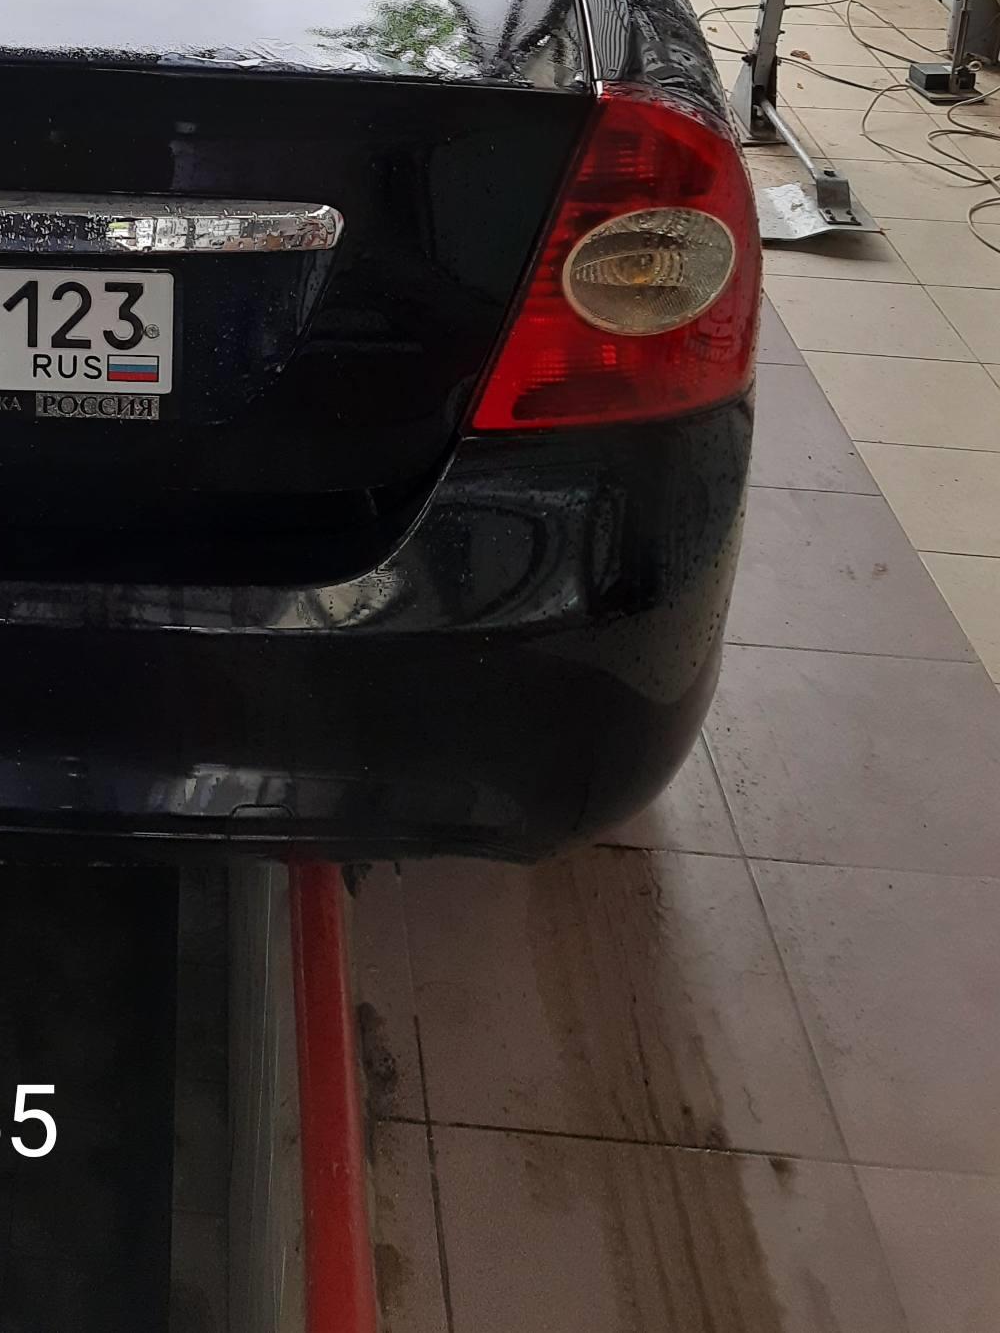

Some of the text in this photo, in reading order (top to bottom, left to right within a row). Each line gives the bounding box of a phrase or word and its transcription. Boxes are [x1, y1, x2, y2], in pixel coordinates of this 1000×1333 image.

[2, 280, 145, 351] 123
[32, 353, 102, 380] RUS
[42, 395, 155, 417] РОССИЯ
